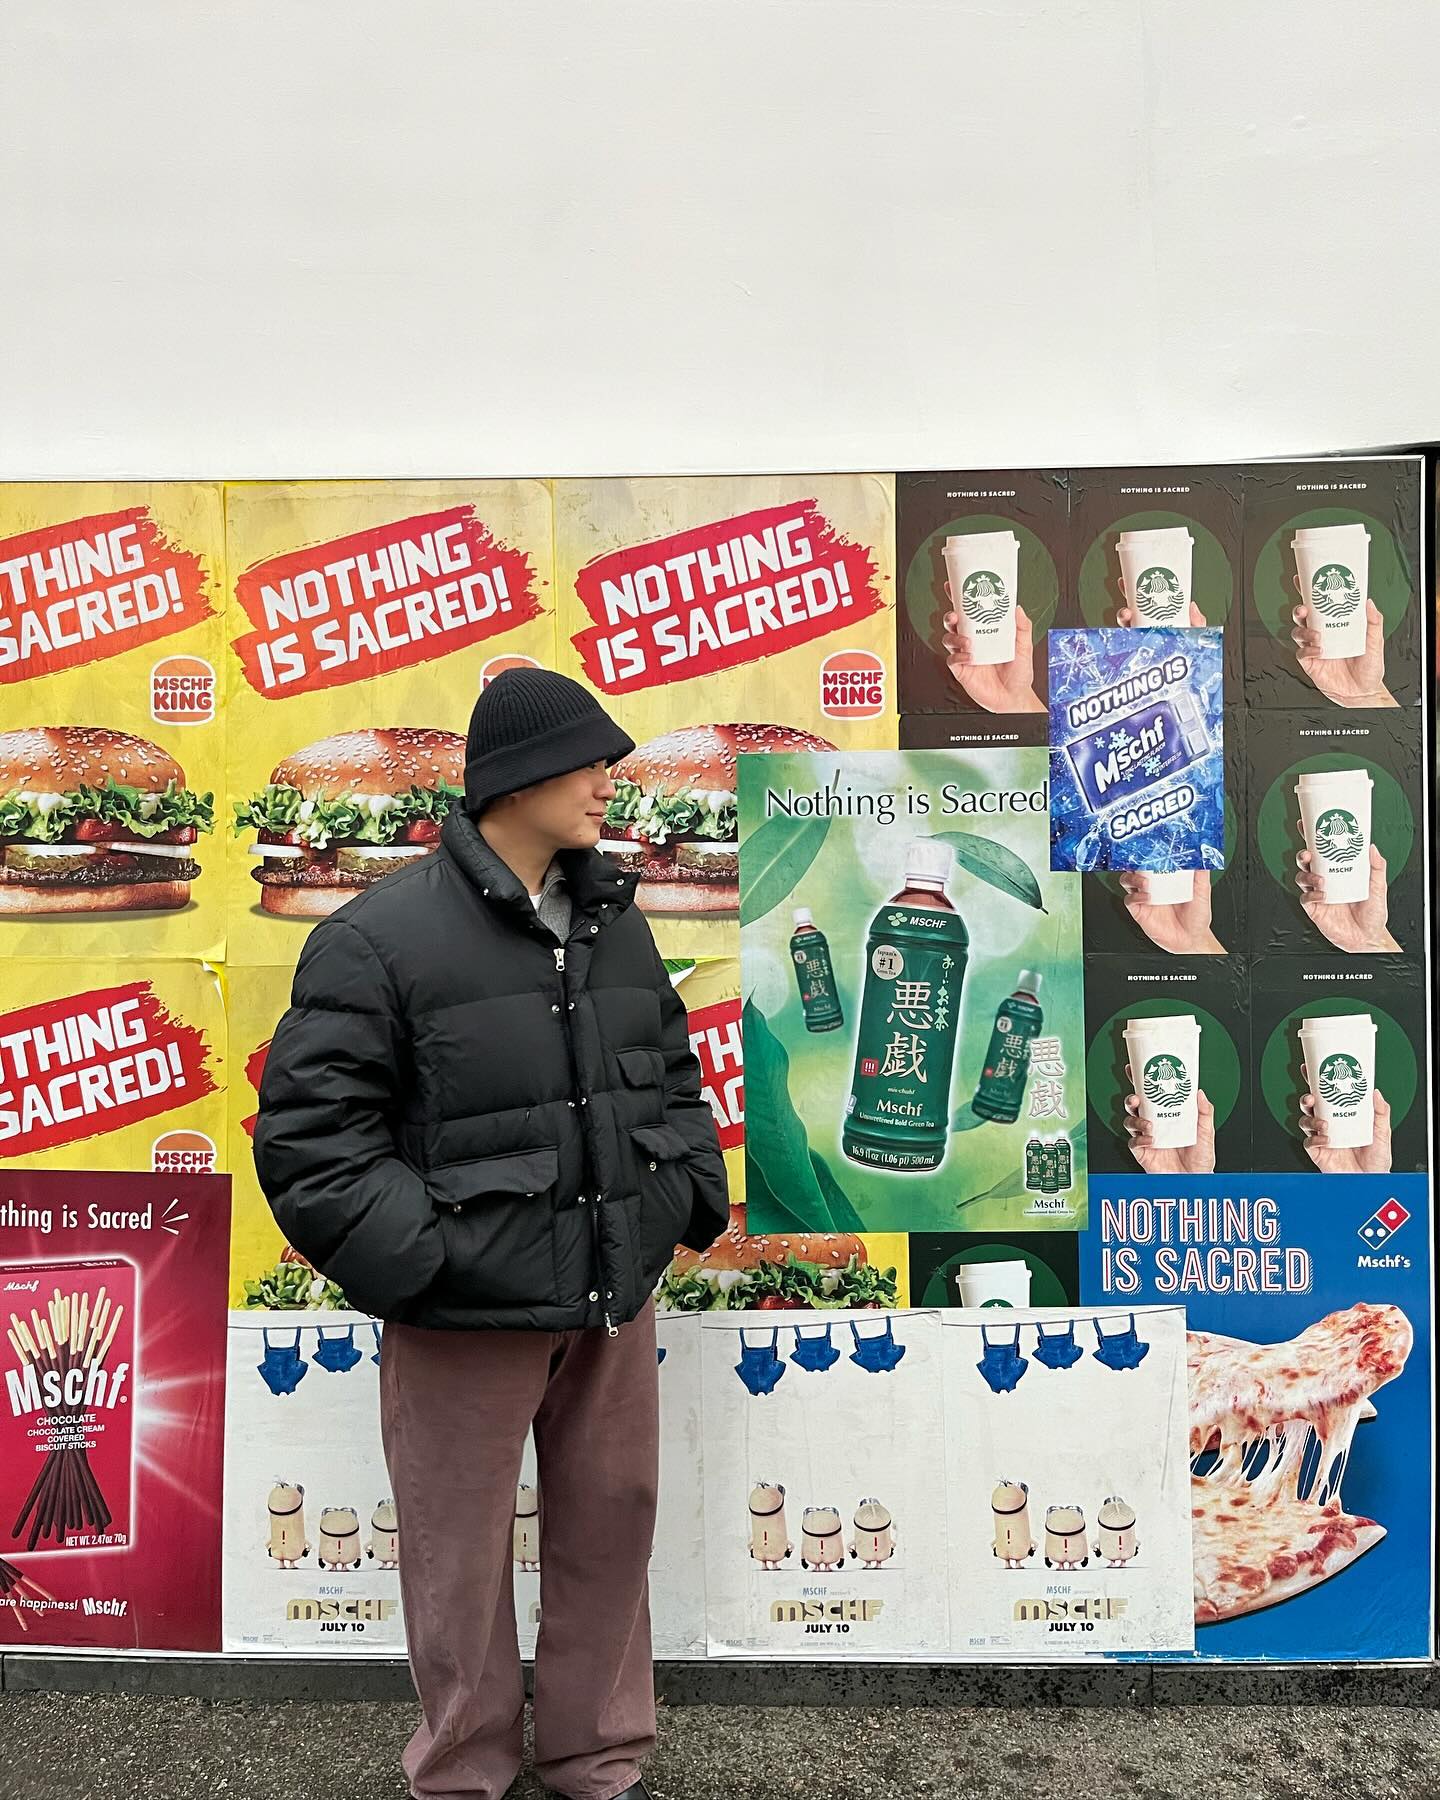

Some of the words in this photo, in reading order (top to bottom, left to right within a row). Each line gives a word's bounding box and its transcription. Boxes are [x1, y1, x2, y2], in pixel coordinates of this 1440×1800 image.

[0, 523, 144, 608] THING
[600, 517, 814, 626] NOTHING
[260, 522, 472, 631] NOTHING
[256, 632, 305, 689] IS
[311, 565, 512, 671] SACRED!
[596, 626, 646, 683] IS
[652, 560, 854, 667] SACRED!
[1325, 621, 1350, 629] MSCHF
[975, 627, 999, 635] MSCHF
[153, 677, 213, 691] MSCHF
[822, 671, 883, 685] MSCHF
[822, 686, 883, 705] KING
[1069, 667, 1164, 728] NOTHING
[1162, 656, 1188, 686] IS
[153, 691, 213, 710] KING
[1093, 715, 1165, 794] Mschf
[767, 785, 895, 825] Nothing
[906, 785, 930, 815] is
[941, 780, 1049, 814] Sacred
[1110, 785, 1194, 840] SACRED
[909, 916, 947, 929] MSCHF
[879, 957, 894, 970] #1
[879, 980, 934, 1083] 悪戯
[0, 998, 147, 1084] THING
[1027, 1037, 1068, 1119] 悪戯
[876, 1098, 923, 1117] Mschf
[154, 1152, 214, 1165] MSCHF
[852, 1145, 864, 1157] 16.9
[881, 1153, 898, 1164] (1.06
[1034, 1198, 1065, 1209] Mschf
[0, 1200, 52, 1233] thing
[62, 1204, 78, 1229] is
[87, 1202, 152, 1230] Sacred
[1101, 1198, 1280, 1244] NOTHING
[1357, 1255, 1411, 1268] Mschf's
[1101, 1248, 1140, 1293] IS
[1155, 1248, 1312, 1293] SACRED
[36, 1413, 97, 1427] CHOCOLATE
[27, 1427, 75, 1437] CHOCOLATE
[76, 1425, 105, 1433] CREAM
[47, 1434, 85, 1443] COVERED
[35, 1442, 67, 1452] BISCUIT
[68, 1440, 97, 1450] STICKS
[65, 1536, 79, 1547] NET
[319, 1586, 344, 1595] MSCHF
[802, 1587, 828, 1596] MSCHF
[1046, 1585, 1072, 1594] MSCHF
[20, 1595, 78, 1611] happiness!
[320, 1622, 348, 1632] JULY
[351, 1622, 365, 1632] 10
[804, 1624, 833, 1633] JULY
[835, 1624, 850, 1633] 10
[1048, 1622, 1077, 1632] JULY
[1079, 1622, 1095, 1632] 10
